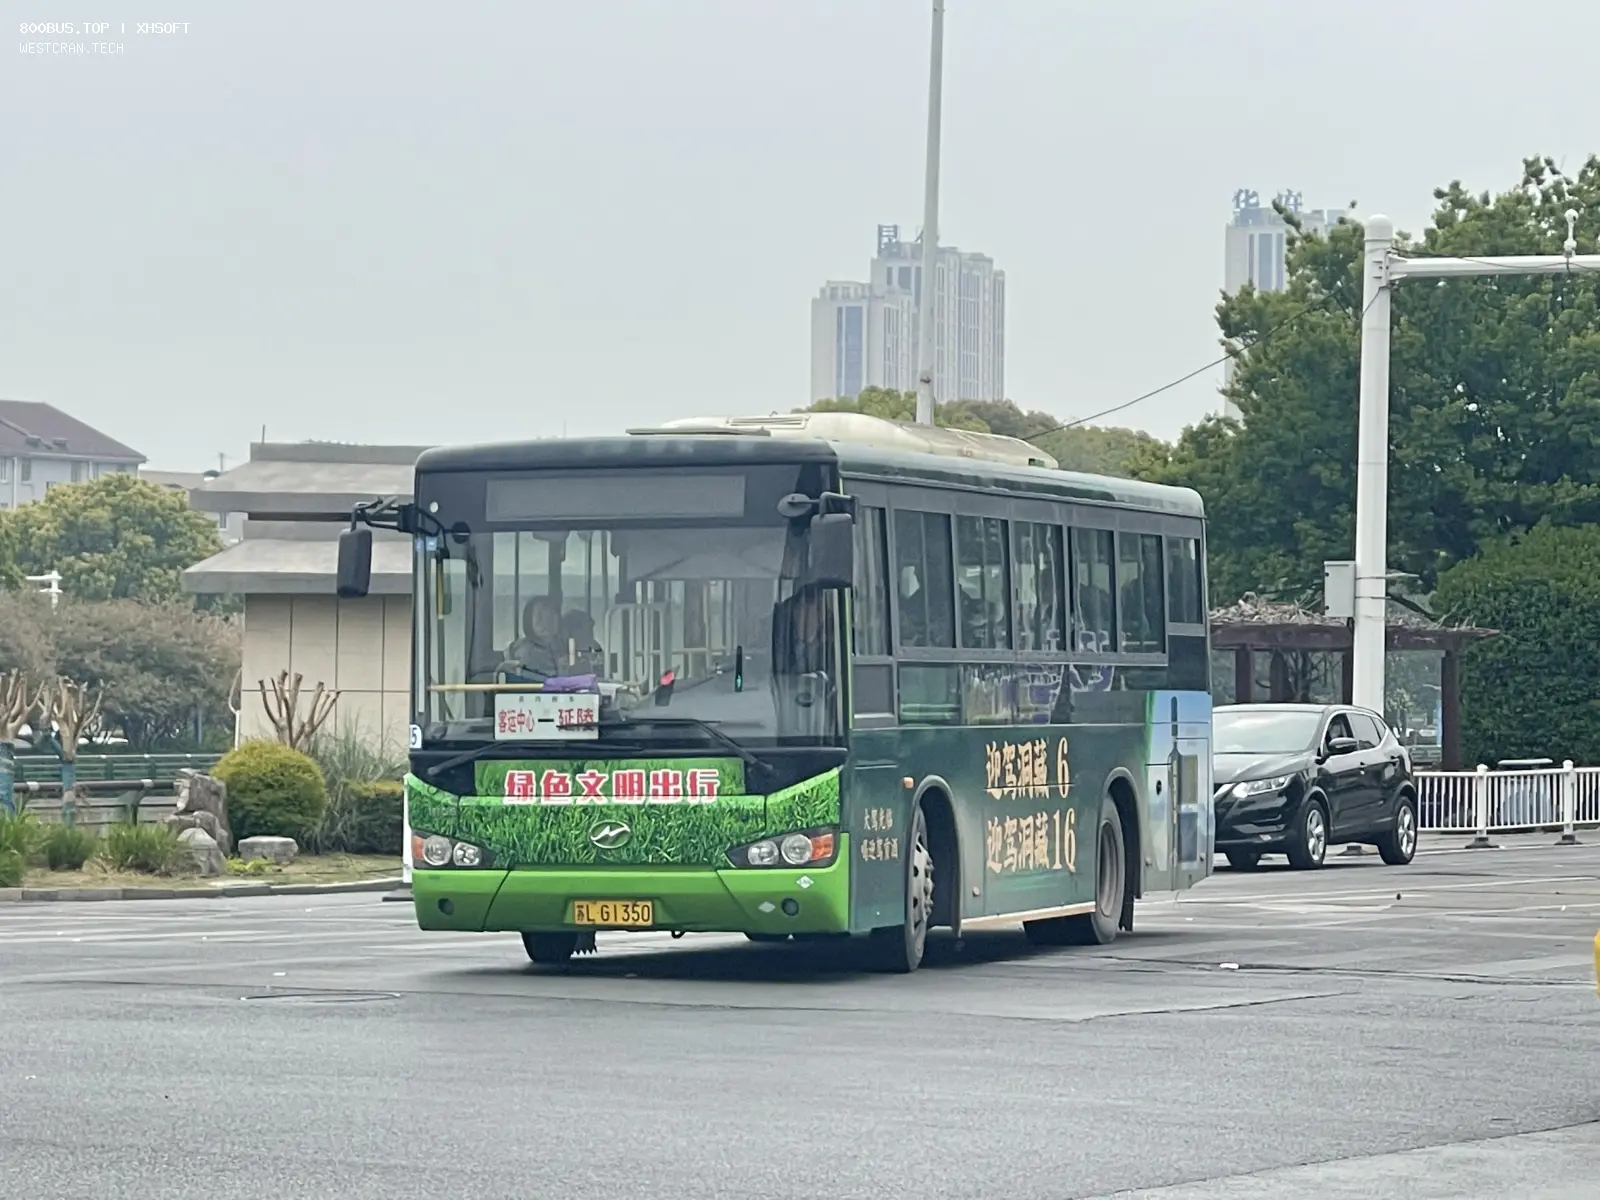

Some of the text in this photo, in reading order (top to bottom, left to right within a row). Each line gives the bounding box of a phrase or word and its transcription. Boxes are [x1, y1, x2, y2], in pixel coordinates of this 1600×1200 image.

[504, 769, 719, 805] 绿色文明出行
[1057, 736, 1070, 799] 6
